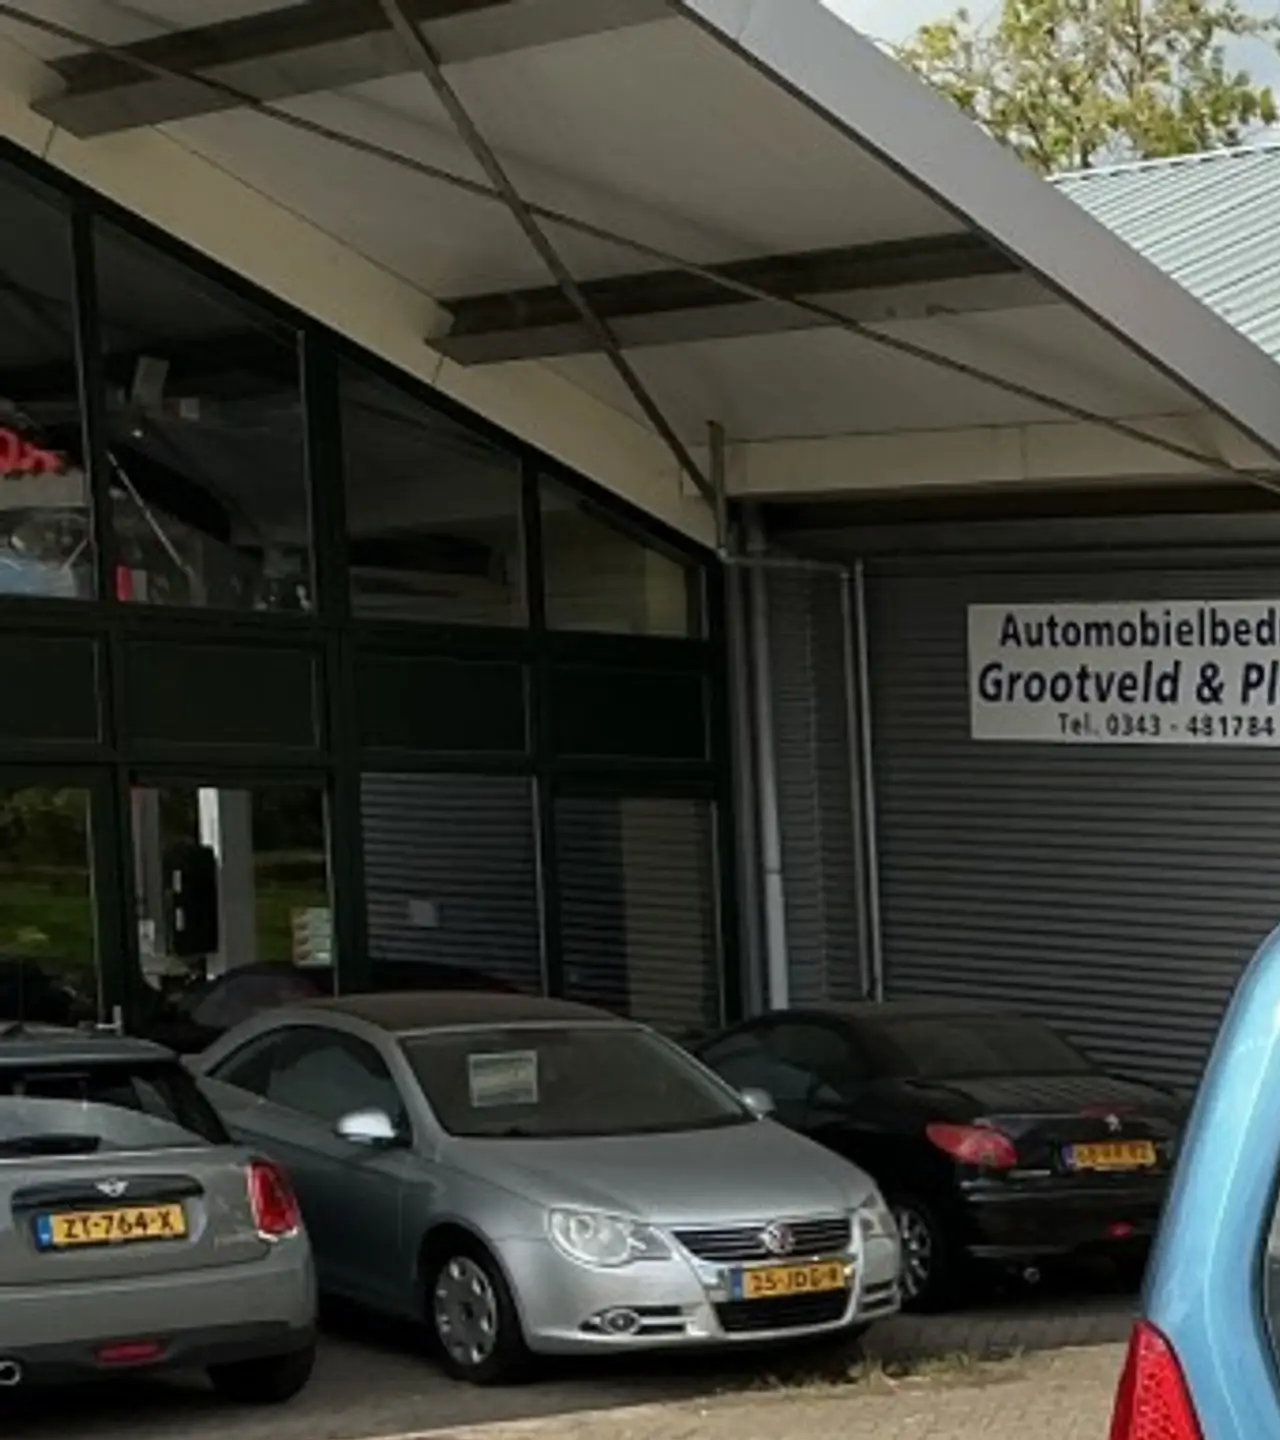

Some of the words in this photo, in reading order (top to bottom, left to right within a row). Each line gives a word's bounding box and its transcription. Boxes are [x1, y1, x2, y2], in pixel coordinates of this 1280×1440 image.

[978, 660, 1181, 704] Grootveld
[1196, 661, 1226, 706] &
[1058, 712, 1099, 736] Tel.
[1105, 713, 1161, 736] 0343
[1185, 715, 1276, 737] 481784
[63, 1211, 175, 1240] ZT-764-X
